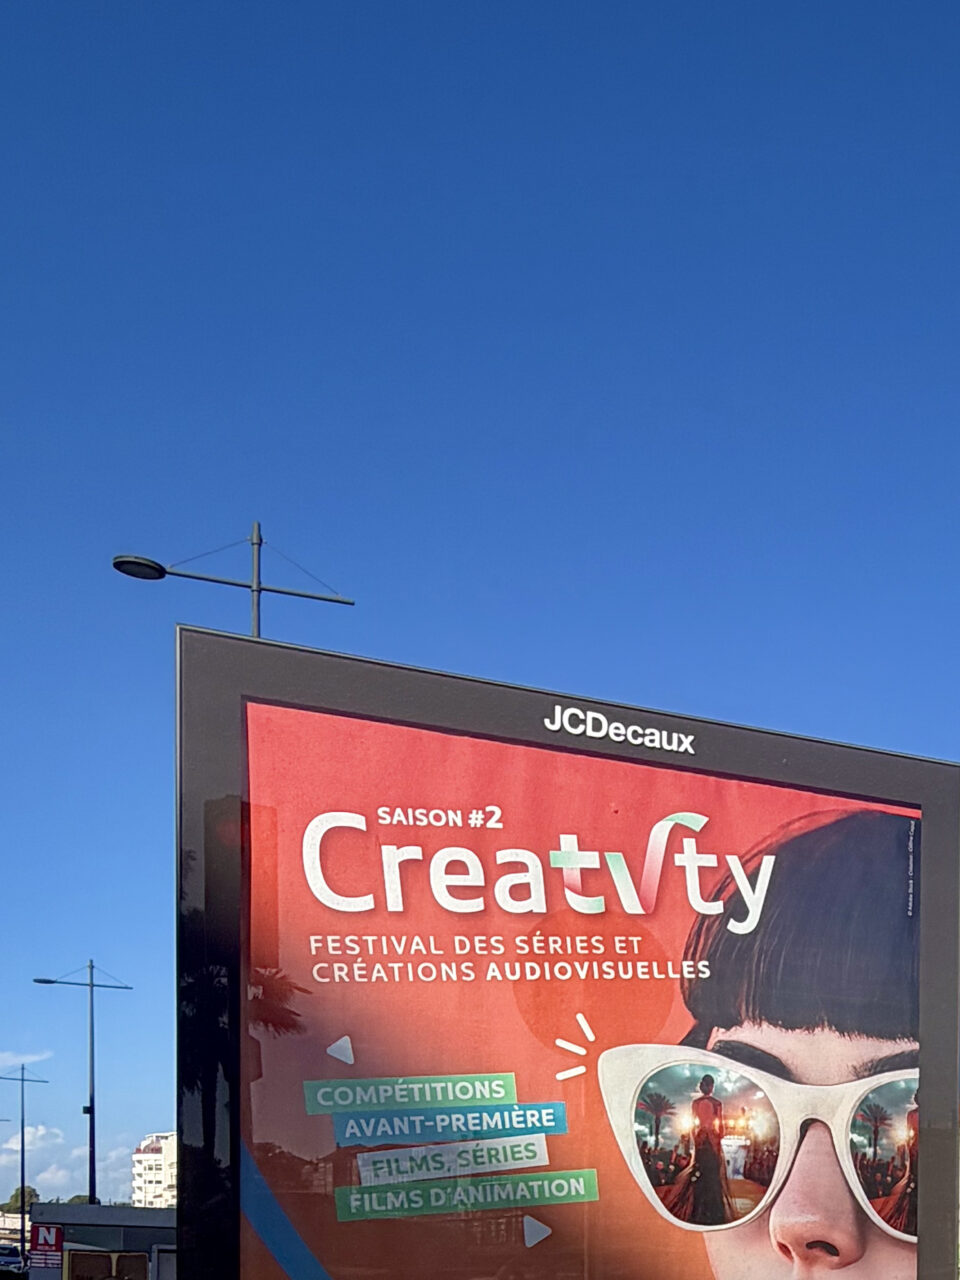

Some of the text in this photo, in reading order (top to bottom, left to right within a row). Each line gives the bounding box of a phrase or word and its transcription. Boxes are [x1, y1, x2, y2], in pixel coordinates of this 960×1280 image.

[544, 704, 695, 755] JCDecaux
[377, 804, 504, 830] SAISON #2
[309, 930, 643, 956] FESTIVAL DES SÉRIES ET
[312, 956, 711, 983] CRÉATIONS AUDIOVISUELLES
[316, 1077, 506, 1107] COMPÉTITIONS
[344, 1104, 556, 1139] AVANT-PREMIÈRE
[371, 1140, 538, 1180] FILMS, SÉRIES
[348, 1176, 586, 1213] FILMS D'ANIMATION
[38, 1227, 56, 1245] N
